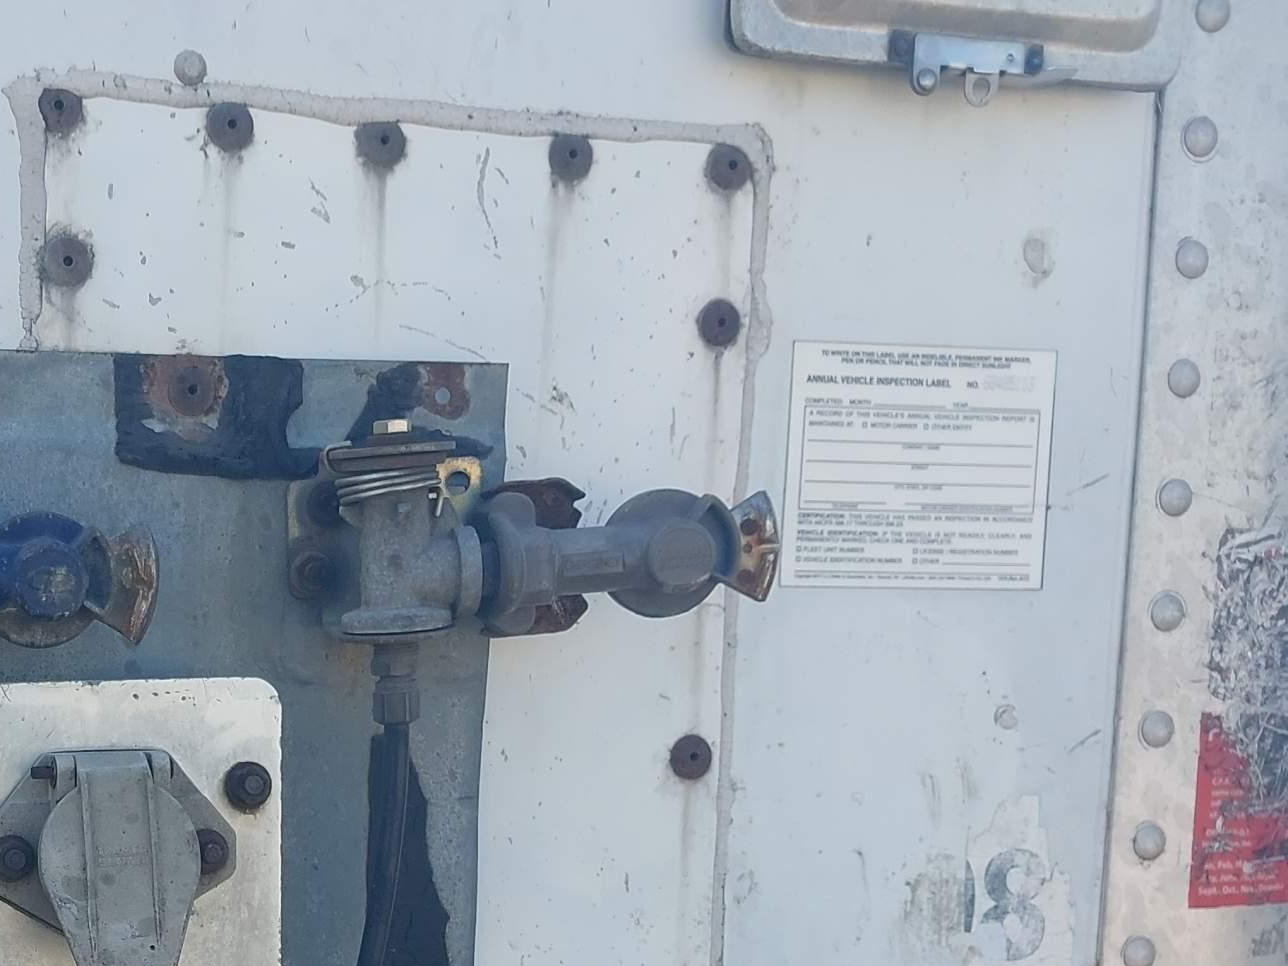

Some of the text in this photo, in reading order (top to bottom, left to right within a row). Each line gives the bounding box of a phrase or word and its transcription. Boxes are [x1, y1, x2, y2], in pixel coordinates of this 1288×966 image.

[807, 375, 840, 384] ANNUAL
[841, 376, 874, 385] VEHICLE
[877, 377, 924, 387] INSPECTION
[926, 379, 951, 388] LABEL
